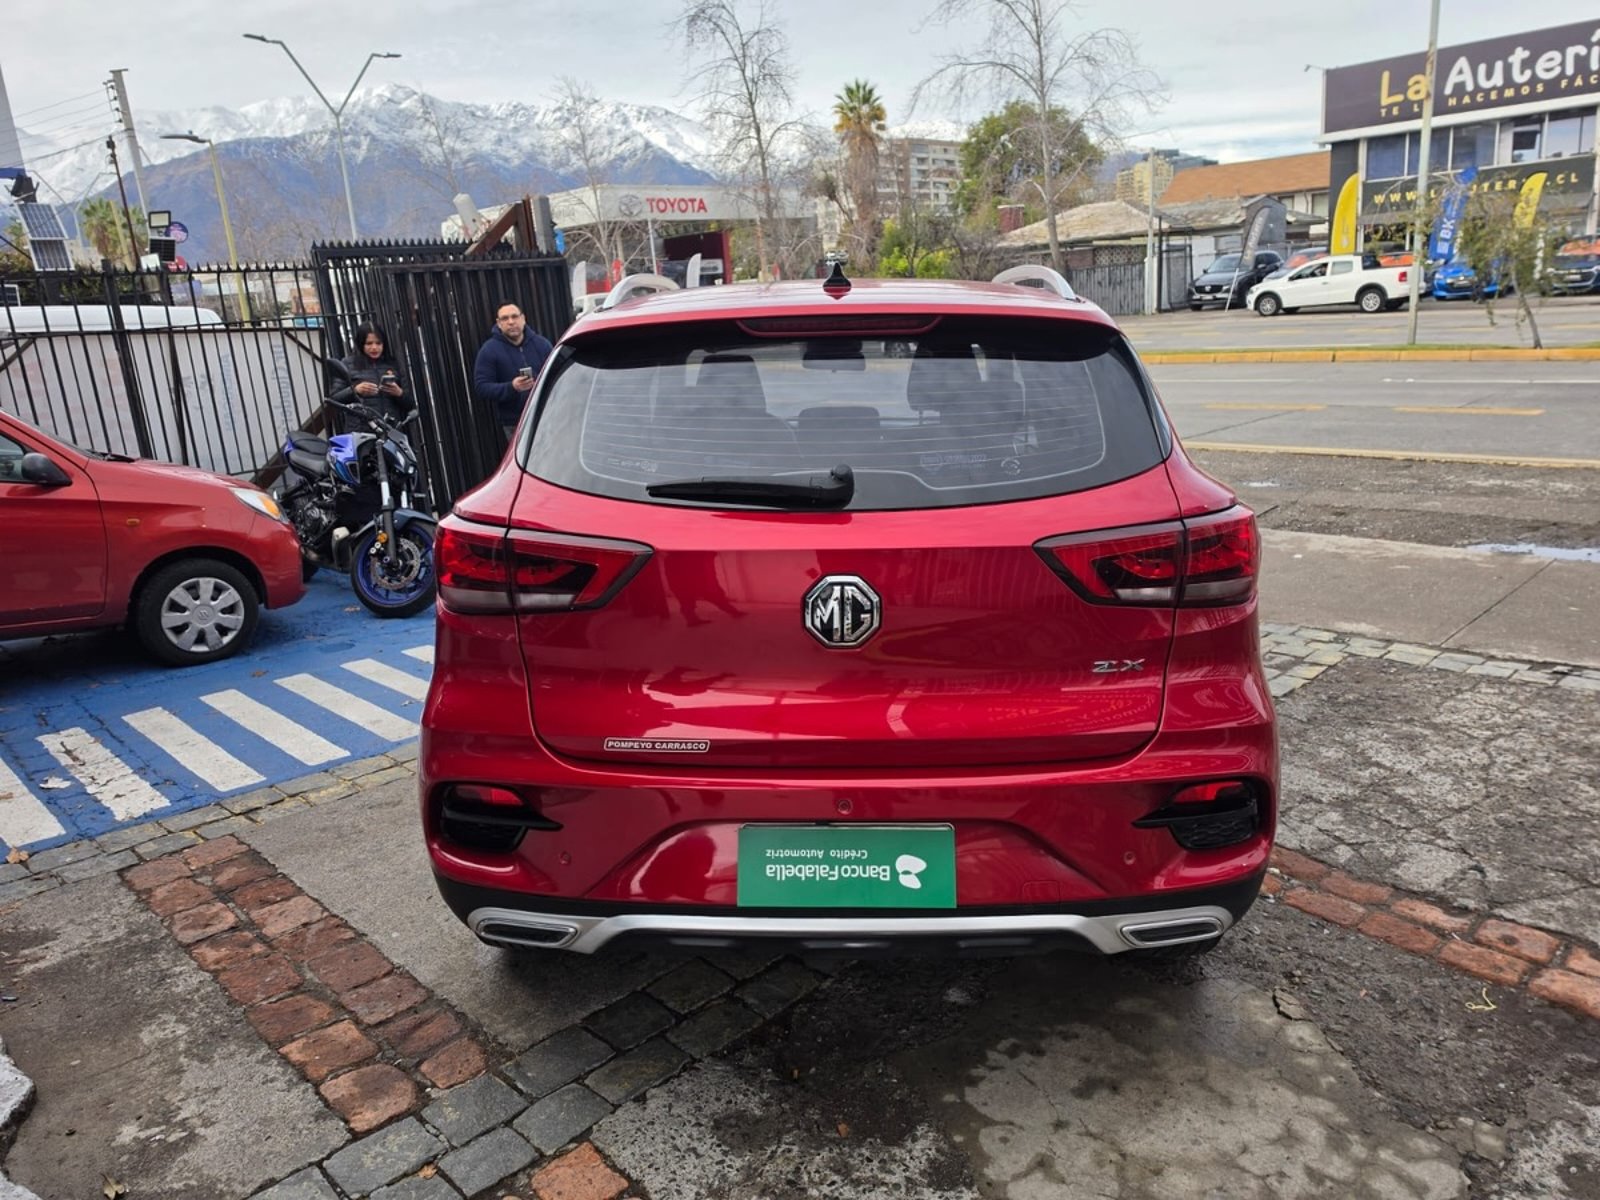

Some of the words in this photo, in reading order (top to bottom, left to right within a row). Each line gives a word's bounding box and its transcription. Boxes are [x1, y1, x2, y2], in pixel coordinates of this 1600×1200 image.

[1380, 70, 1427, 107] La
[1380, 106, 1400, 118] TE
[1447, 82, 1545, 107] HACEMOS
[645, 197, 708, 214] TOYOTA
[813, 584, 872, 642] MG
[1091, 658, 1146, 673] ZX
[607, 740, 653, 749] POMPEYO
[654, 741, 707, 750] CARRASCO
[765, 849, 825, 860] Automotriz
[829, 849, 869, 861] Crédito
